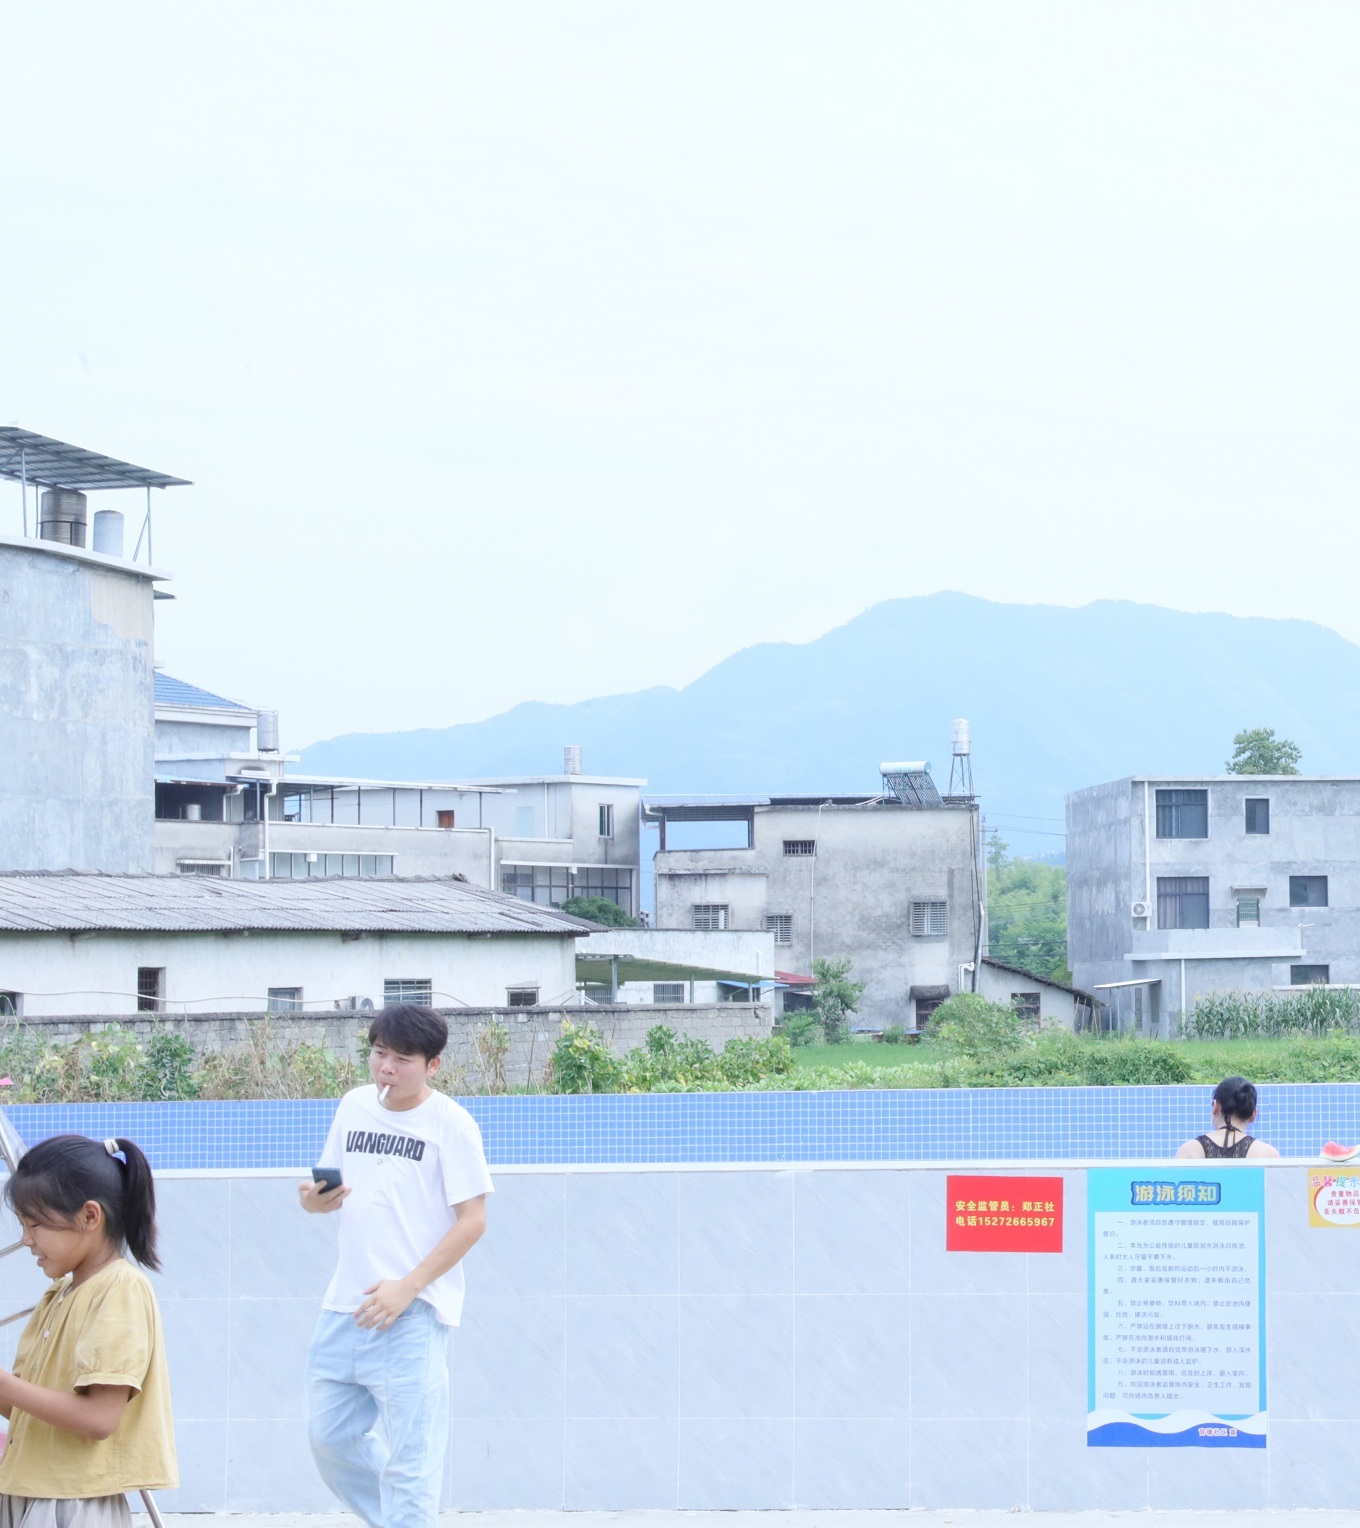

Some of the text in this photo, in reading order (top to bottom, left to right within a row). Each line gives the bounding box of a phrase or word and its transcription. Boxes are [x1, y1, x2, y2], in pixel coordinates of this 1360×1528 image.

[346, 1130, 426, 1162] VANGUARD
[1310, 1176, 1360, 1188] 温馨提示
[1135, 1184, 1217, 1202] 游泳须知
[955, 1215, 1055, 1227] 电话15272665967
